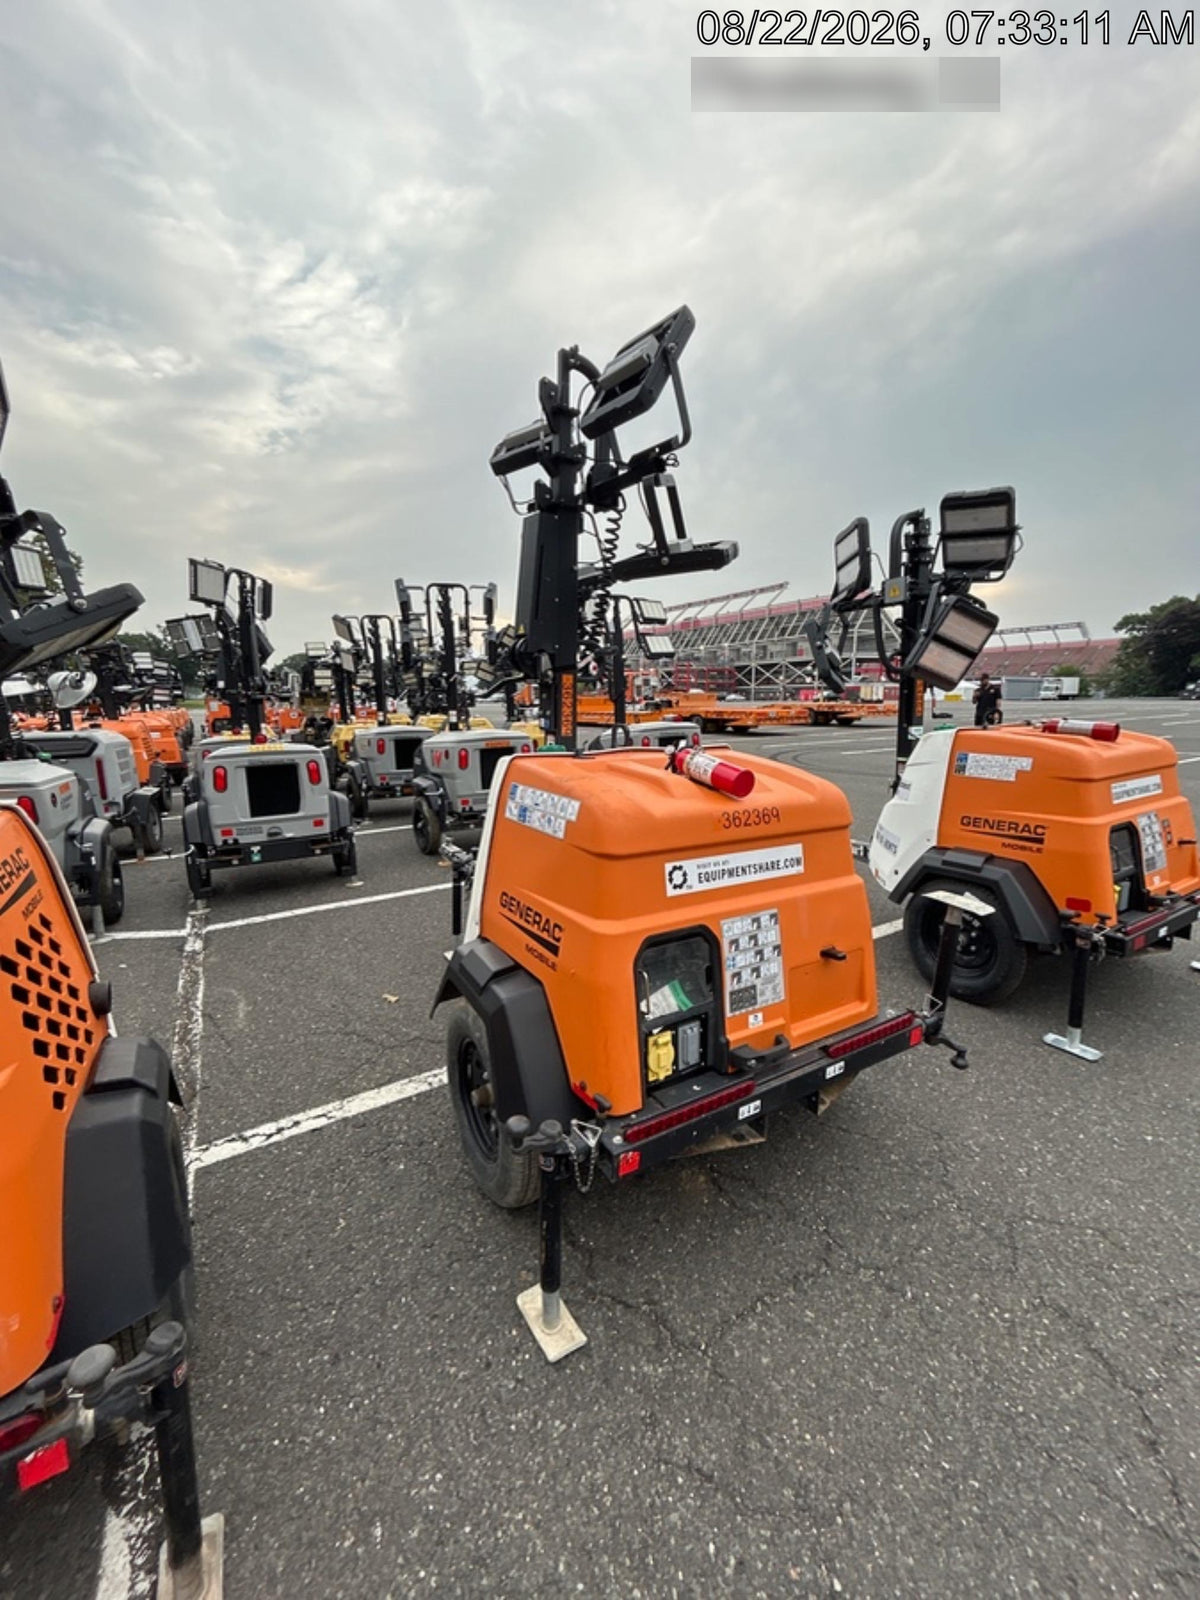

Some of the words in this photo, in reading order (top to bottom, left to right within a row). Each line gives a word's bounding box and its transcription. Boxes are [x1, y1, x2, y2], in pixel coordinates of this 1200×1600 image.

[721, 806, 781, 829] 362369
[960, 815, 1046, 837] GENERAC
[1001, 842, 1044, 854] MOBILE
[698, 856, 802, 884] EQUIPMENTSHARE.COM
[500, 891, 564, 943] GENERAC
[524, 943, 557, 972] MOBILE
